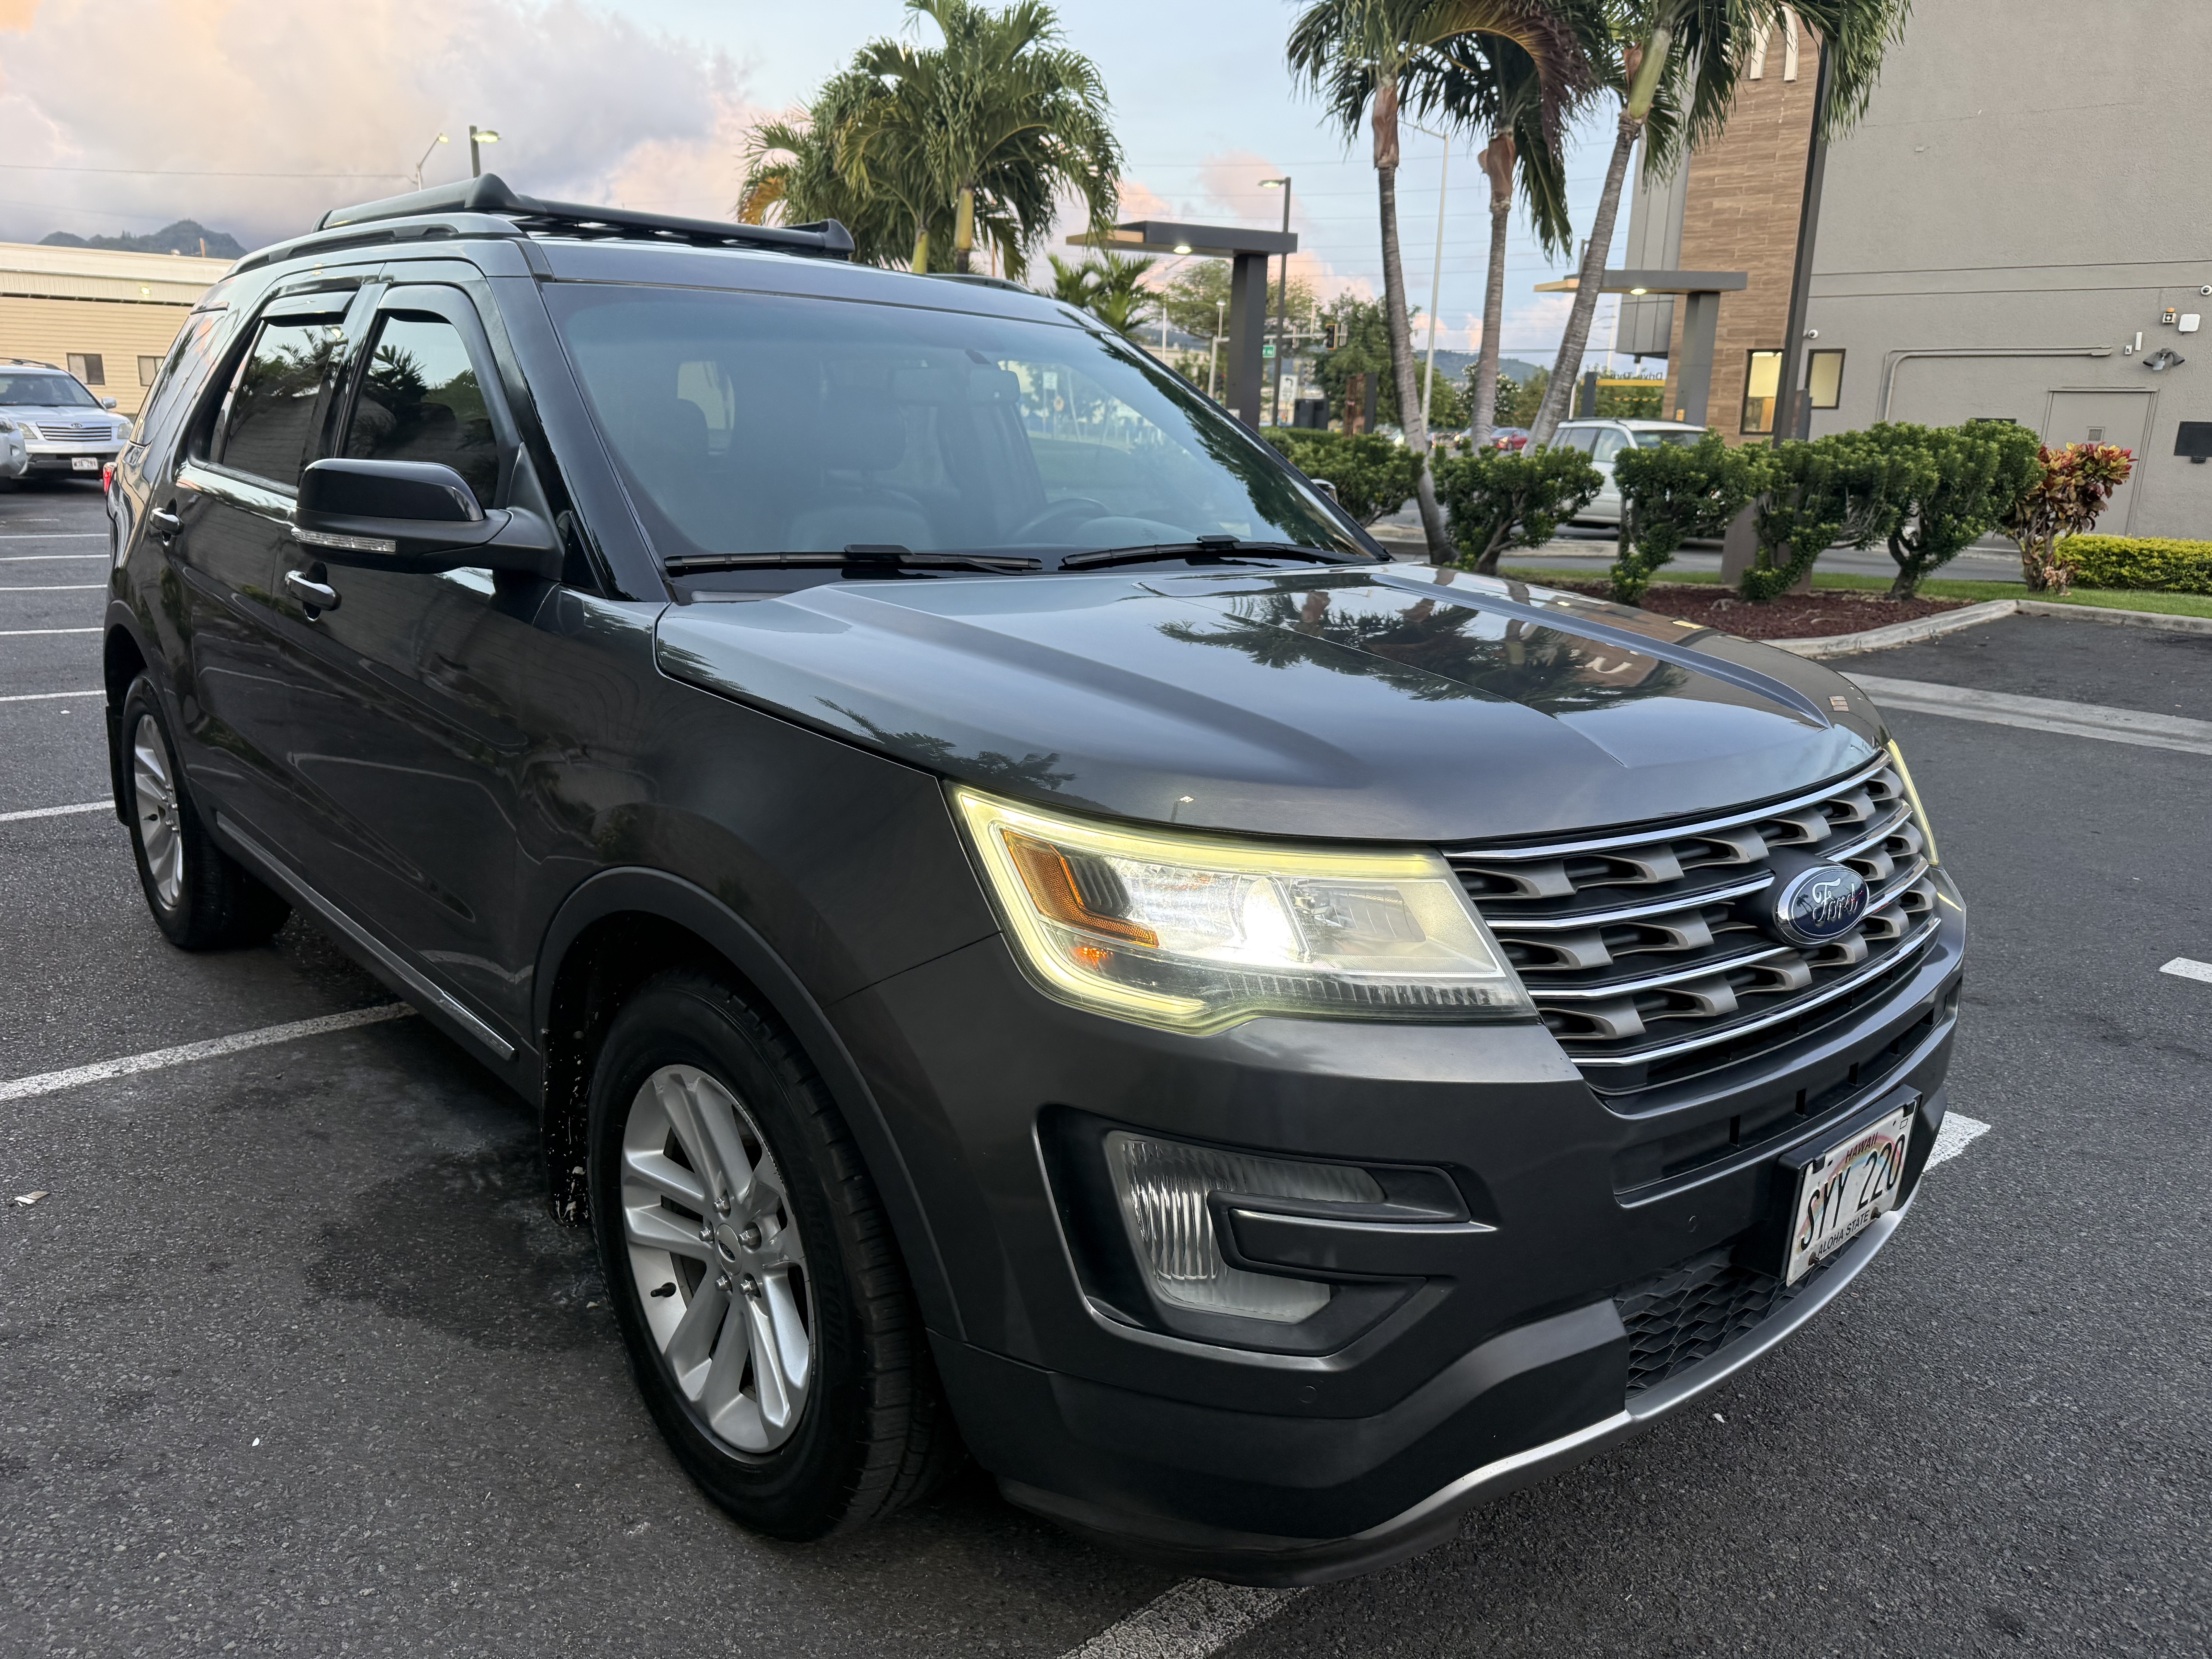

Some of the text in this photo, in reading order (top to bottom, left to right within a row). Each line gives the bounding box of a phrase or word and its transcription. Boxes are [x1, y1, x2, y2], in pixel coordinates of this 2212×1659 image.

[1812, 878, 1863, 926] Ford
[1845, 1132, 1878, 1163] HAWAII
[1801, 1133, 1905, 1250] SYY 220
[1817, 1209, 1870, 1257] ALOHA STATE
